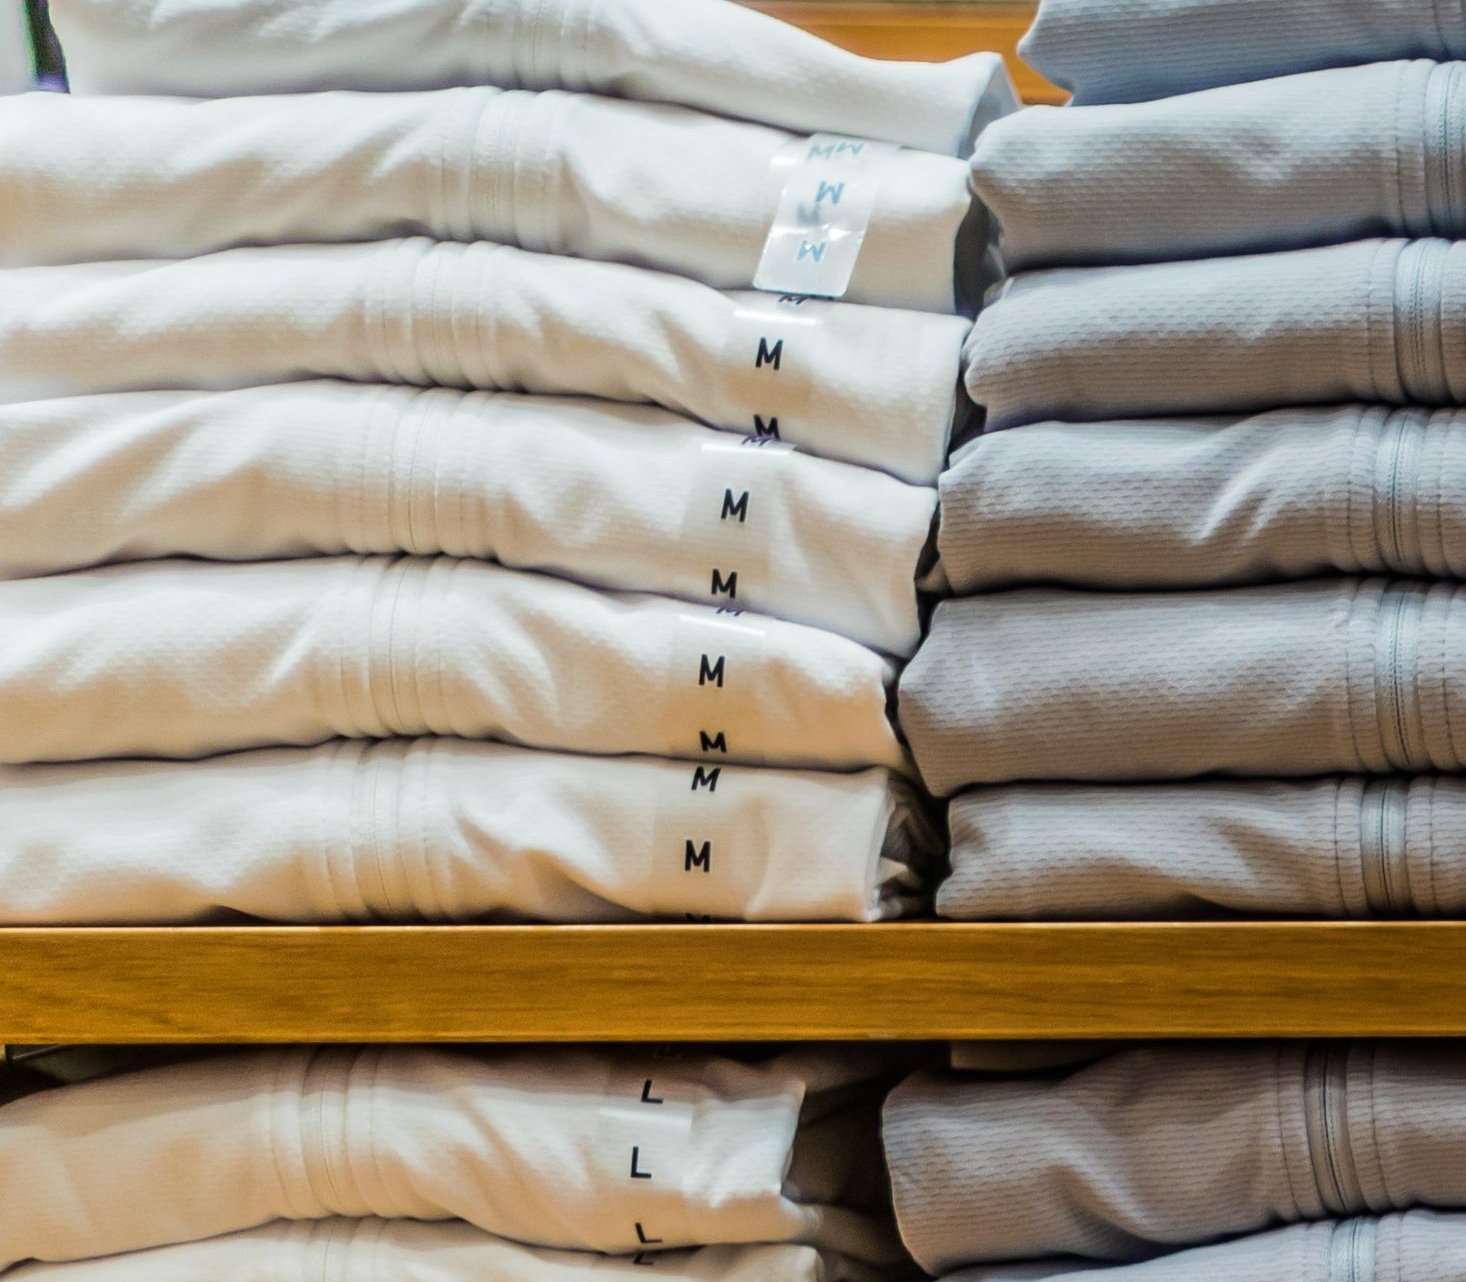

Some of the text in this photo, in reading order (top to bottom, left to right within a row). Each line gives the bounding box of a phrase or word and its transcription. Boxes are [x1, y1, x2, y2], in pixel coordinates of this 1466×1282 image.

[755, 338, 783, 370] M
[754, 415, 780, 439] M
[721, 489, 749, 523] M
[711, 569, 738, 598] M
[698, 654, 725, 687] M
[700, 731, 727, 753] M
[691, 767, 721, 791] M
[684, 840, 711, 872] M
[641, 1079, 663, 1103] L
[631, 1146, 652, 1178] L
[635, 1222, 662, 1243] L
